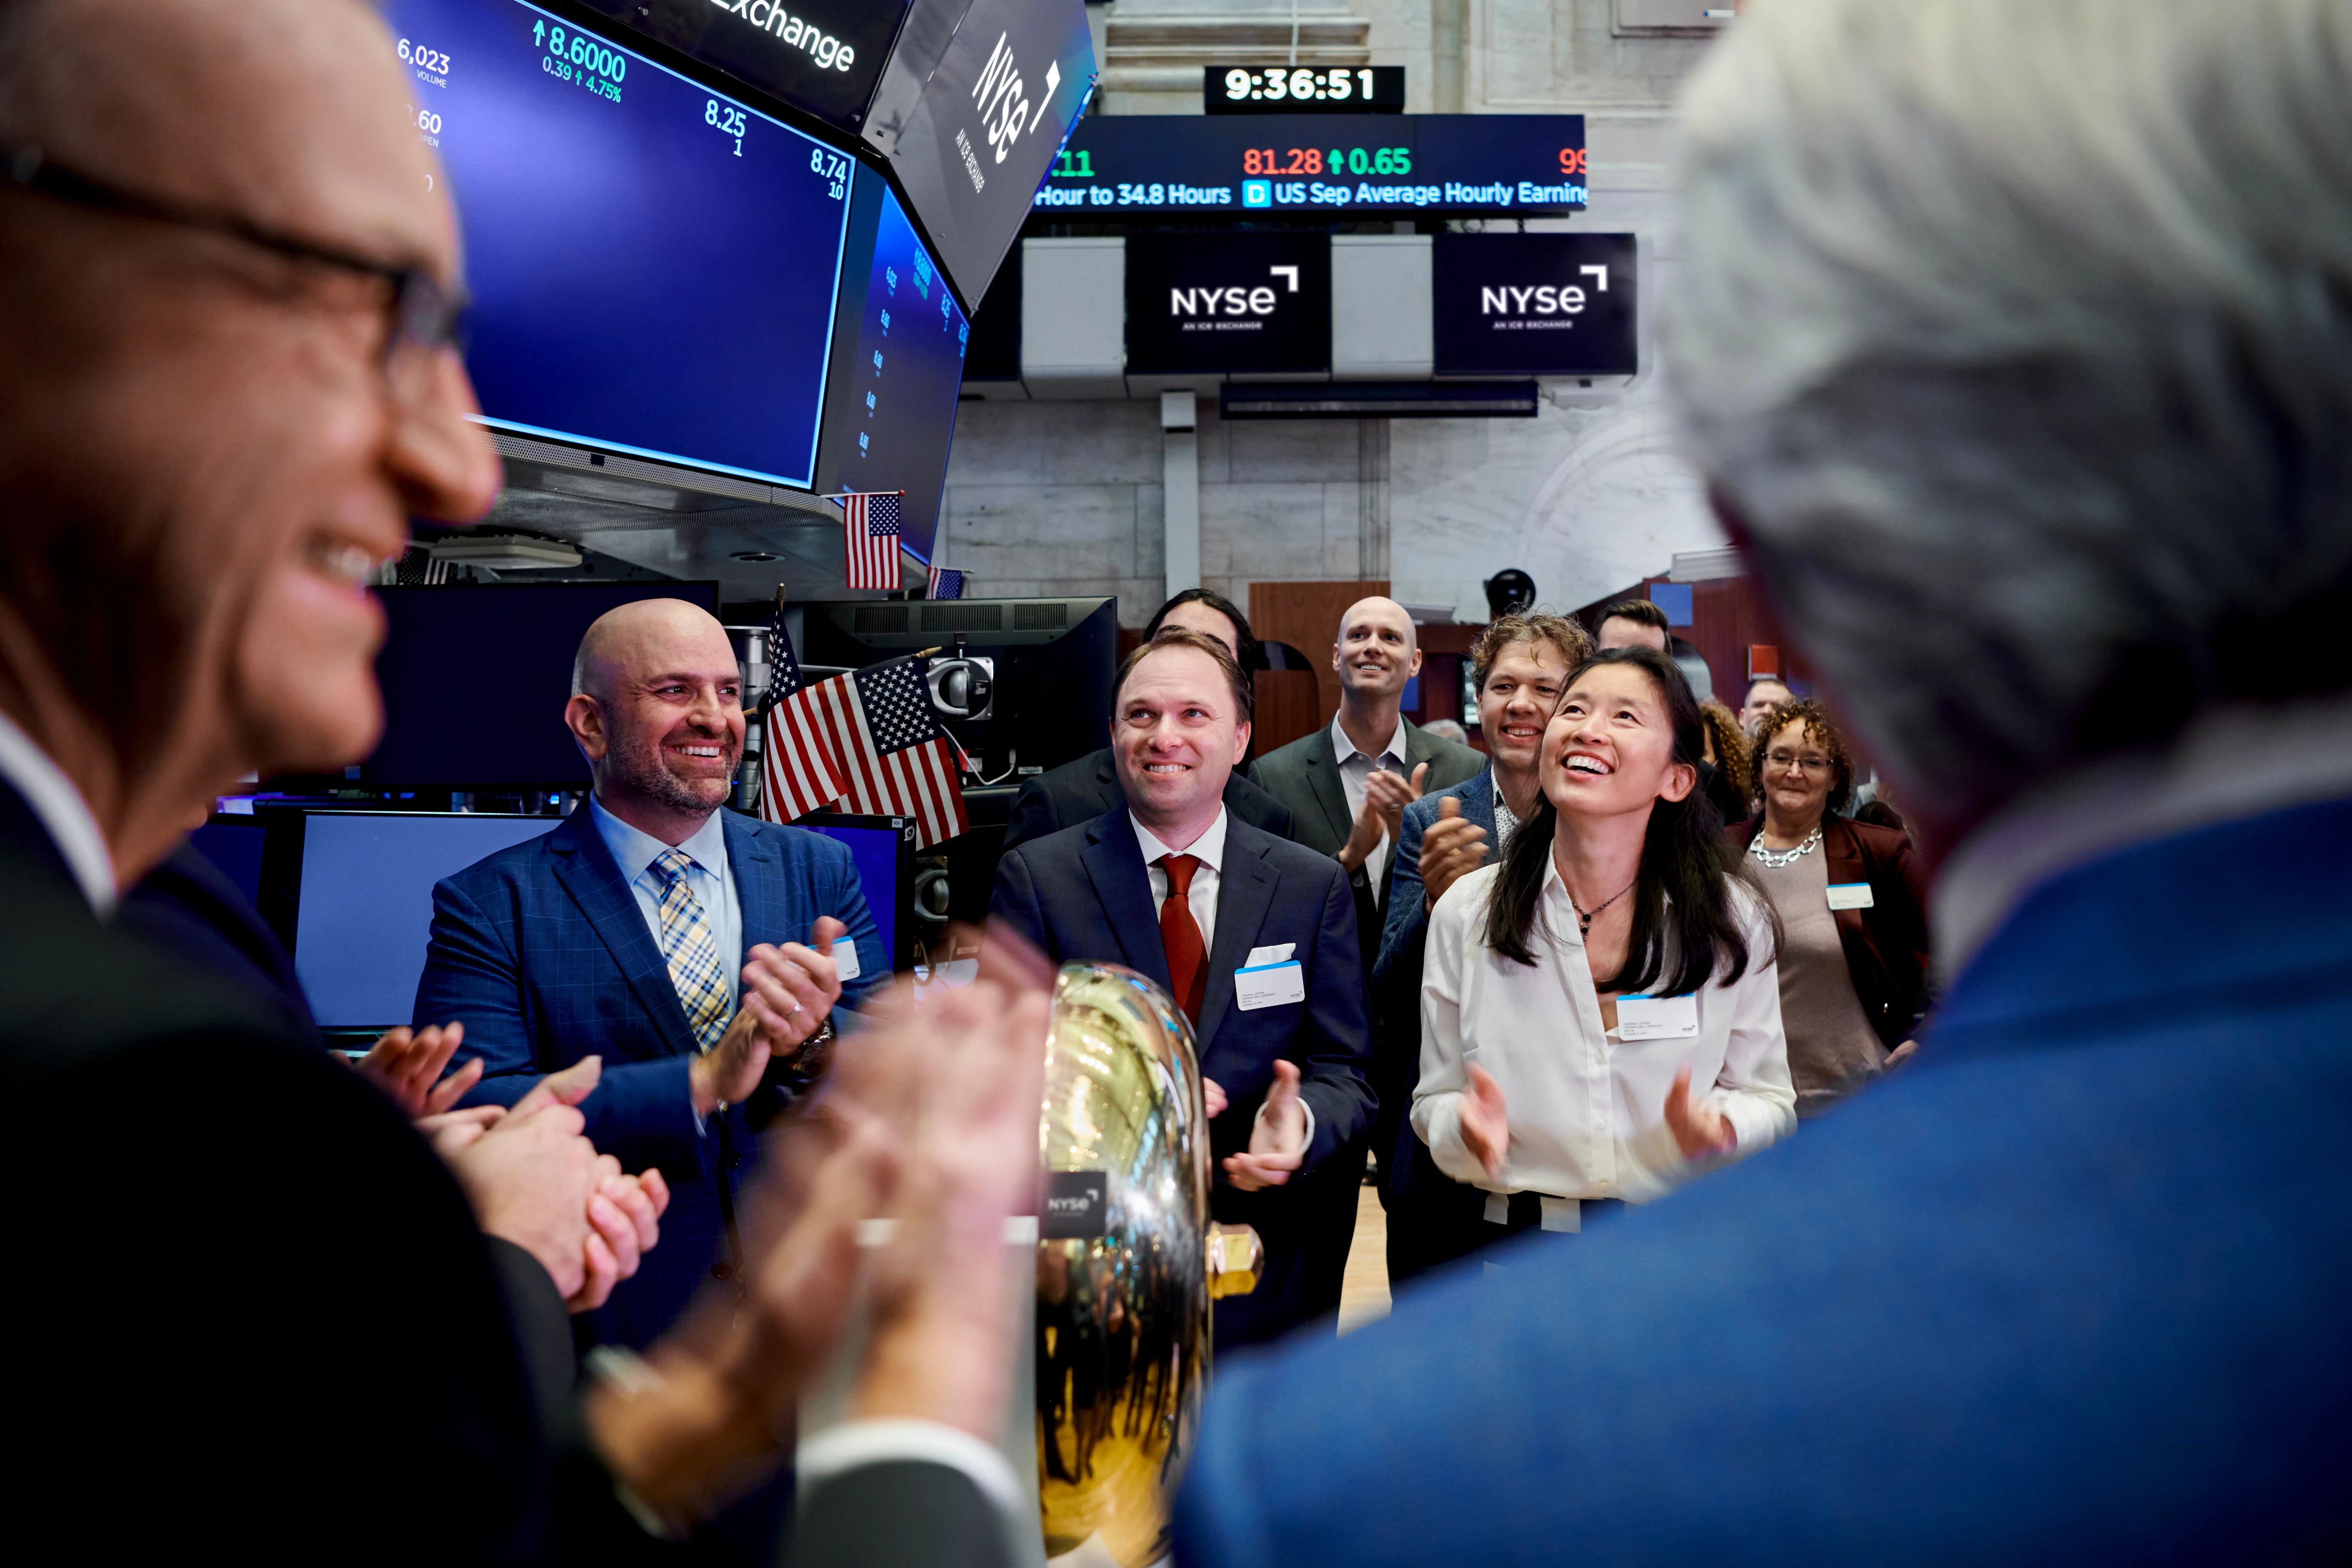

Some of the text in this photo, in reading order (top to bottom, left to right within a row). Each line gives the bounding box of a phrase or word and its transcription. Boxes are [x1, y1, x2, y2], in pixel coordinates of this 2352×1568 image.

[710, 0, 854, 71] xchange
[549, 27, 626, 83] 8.6000
[417, 69, 447, 89] VOLUME
[543, 56, 622, 103] 0.39 4.75%
[1225, 69, 1373, 100] 9:36:51
[407, 103, 441, 134] .60
[705, 99, 746, 137] 8.25
[734, 139, 742, 157] 1
[1244, 148, 1323, 175] 81.28
[1348, 147, 1412, 175] 0.65
[811, 149, 846, 184] 8.74
[828, 182, 844, 200] 10
[1090, 186, 1114, 205] to
[1117, 184, 1165, 205] 34.8
[1168, 184, 1232, 204] Hours
[1275, 182, 1307, 204] US
[1310, 182, 1351, 206] Sep
[1355, 182, 1442, 206] Average
[1445, 181, 1514, 206] Hourly
